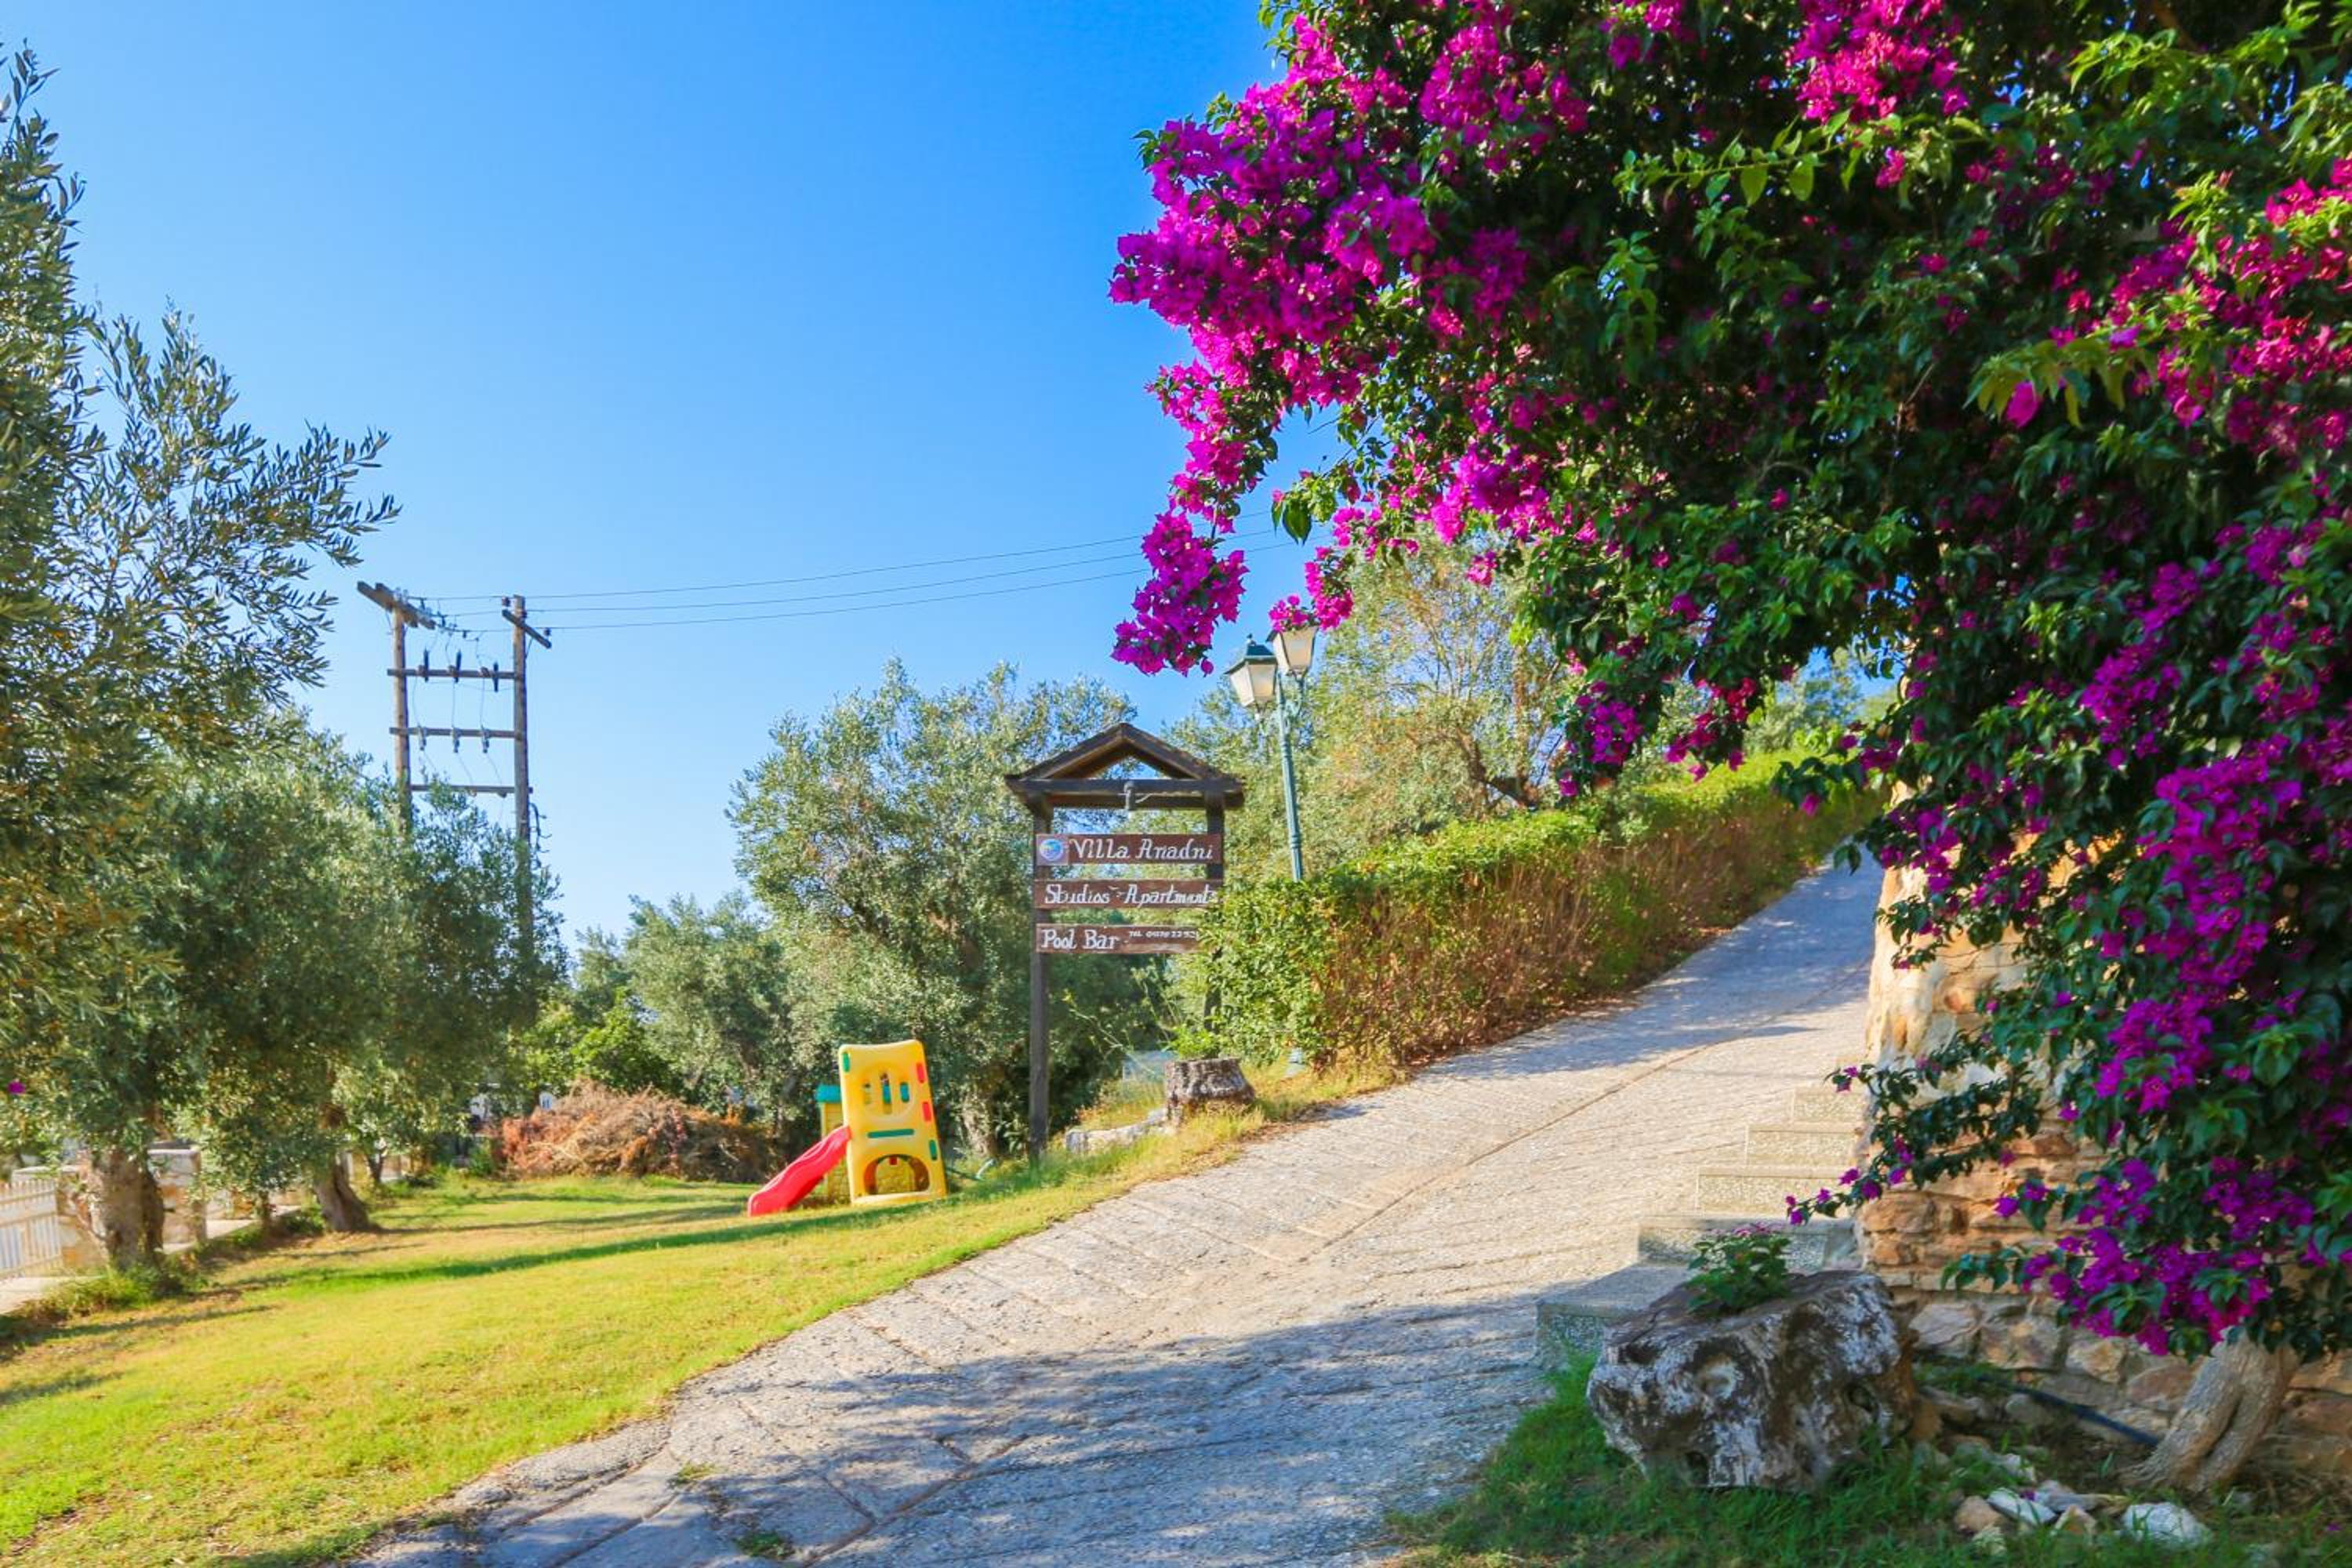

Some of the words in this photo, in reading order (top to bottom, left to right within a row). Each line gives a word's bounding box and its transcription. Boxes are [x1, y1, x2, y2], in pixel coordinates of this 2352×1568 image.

[1069, 838, 1129, 859] Villa
[1044, 884, 1110, 904] Studios
[1040, 928, 1077, 949] Pool
[1082, 929, 1120, 949] Bar
